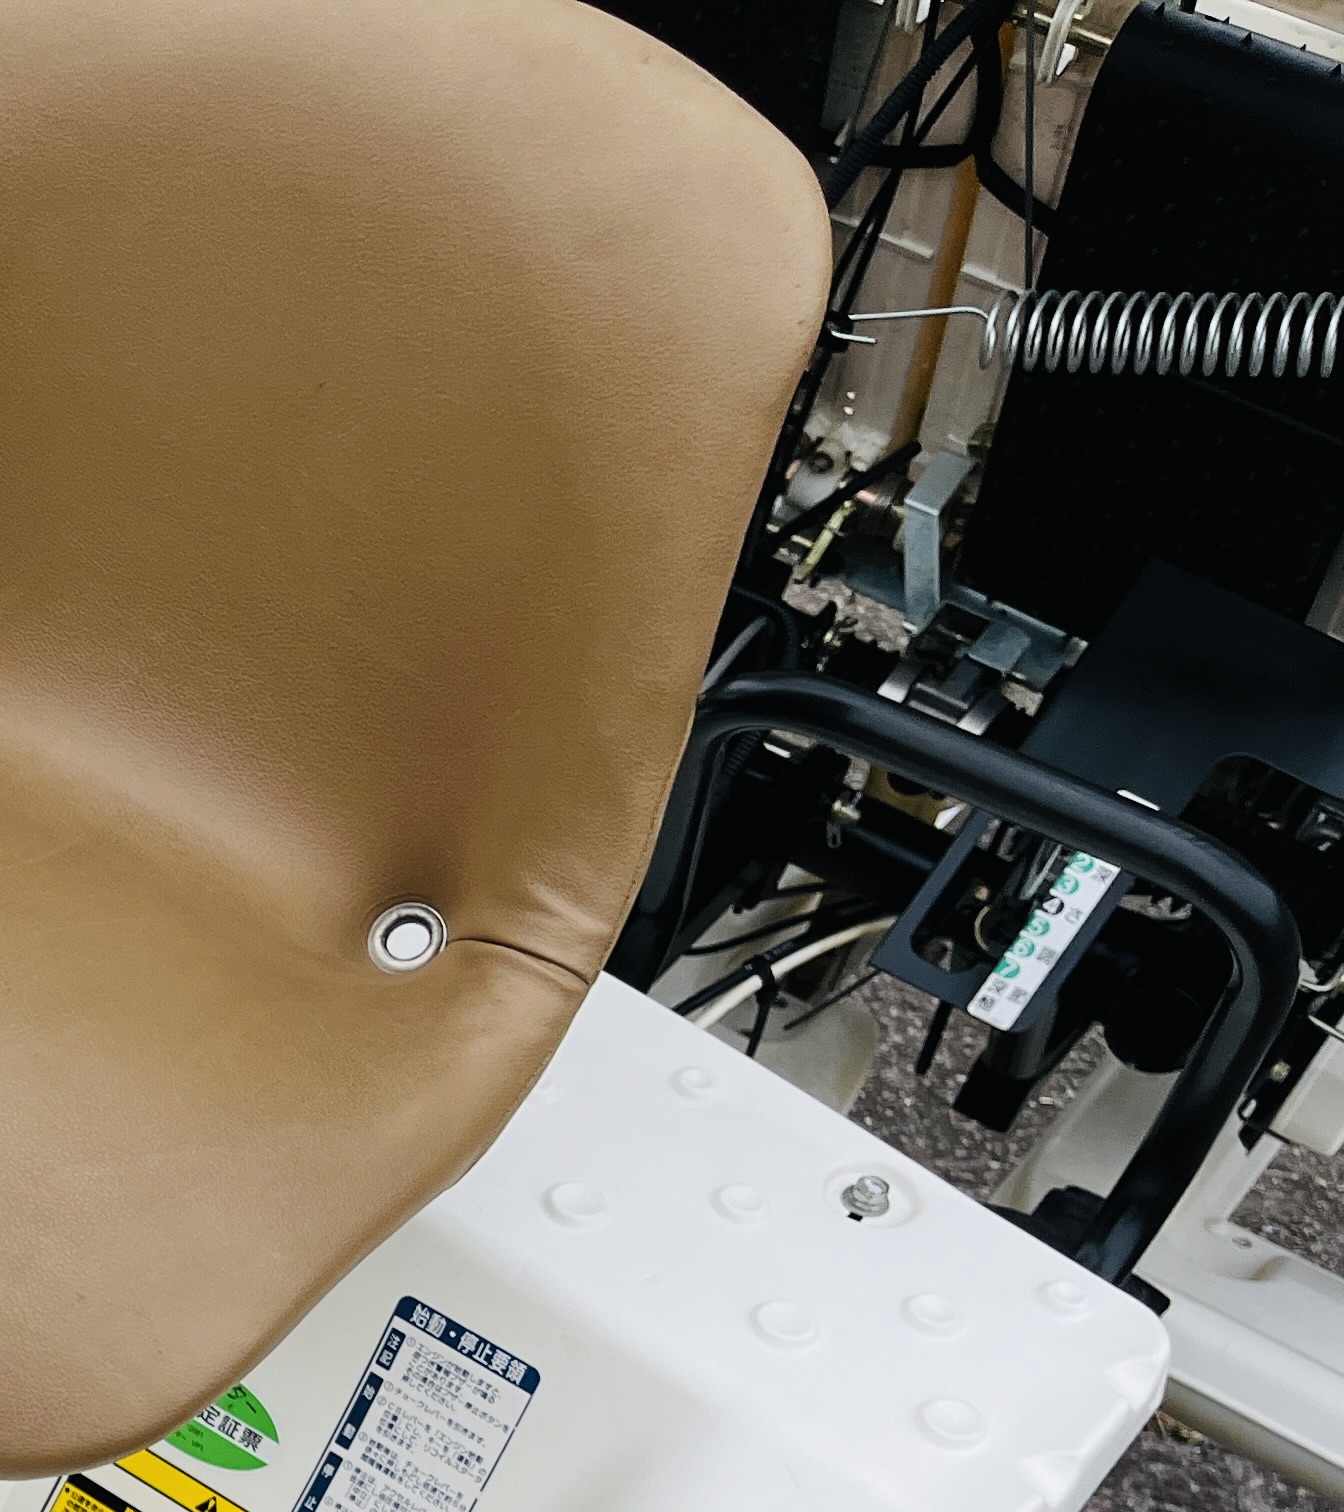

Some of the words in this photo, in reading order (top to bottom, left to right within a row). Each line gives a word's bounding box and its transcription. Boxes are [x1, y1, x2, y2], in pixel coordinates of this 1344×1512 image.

[408, 1303, 527, 1386] 始動・停止要領
